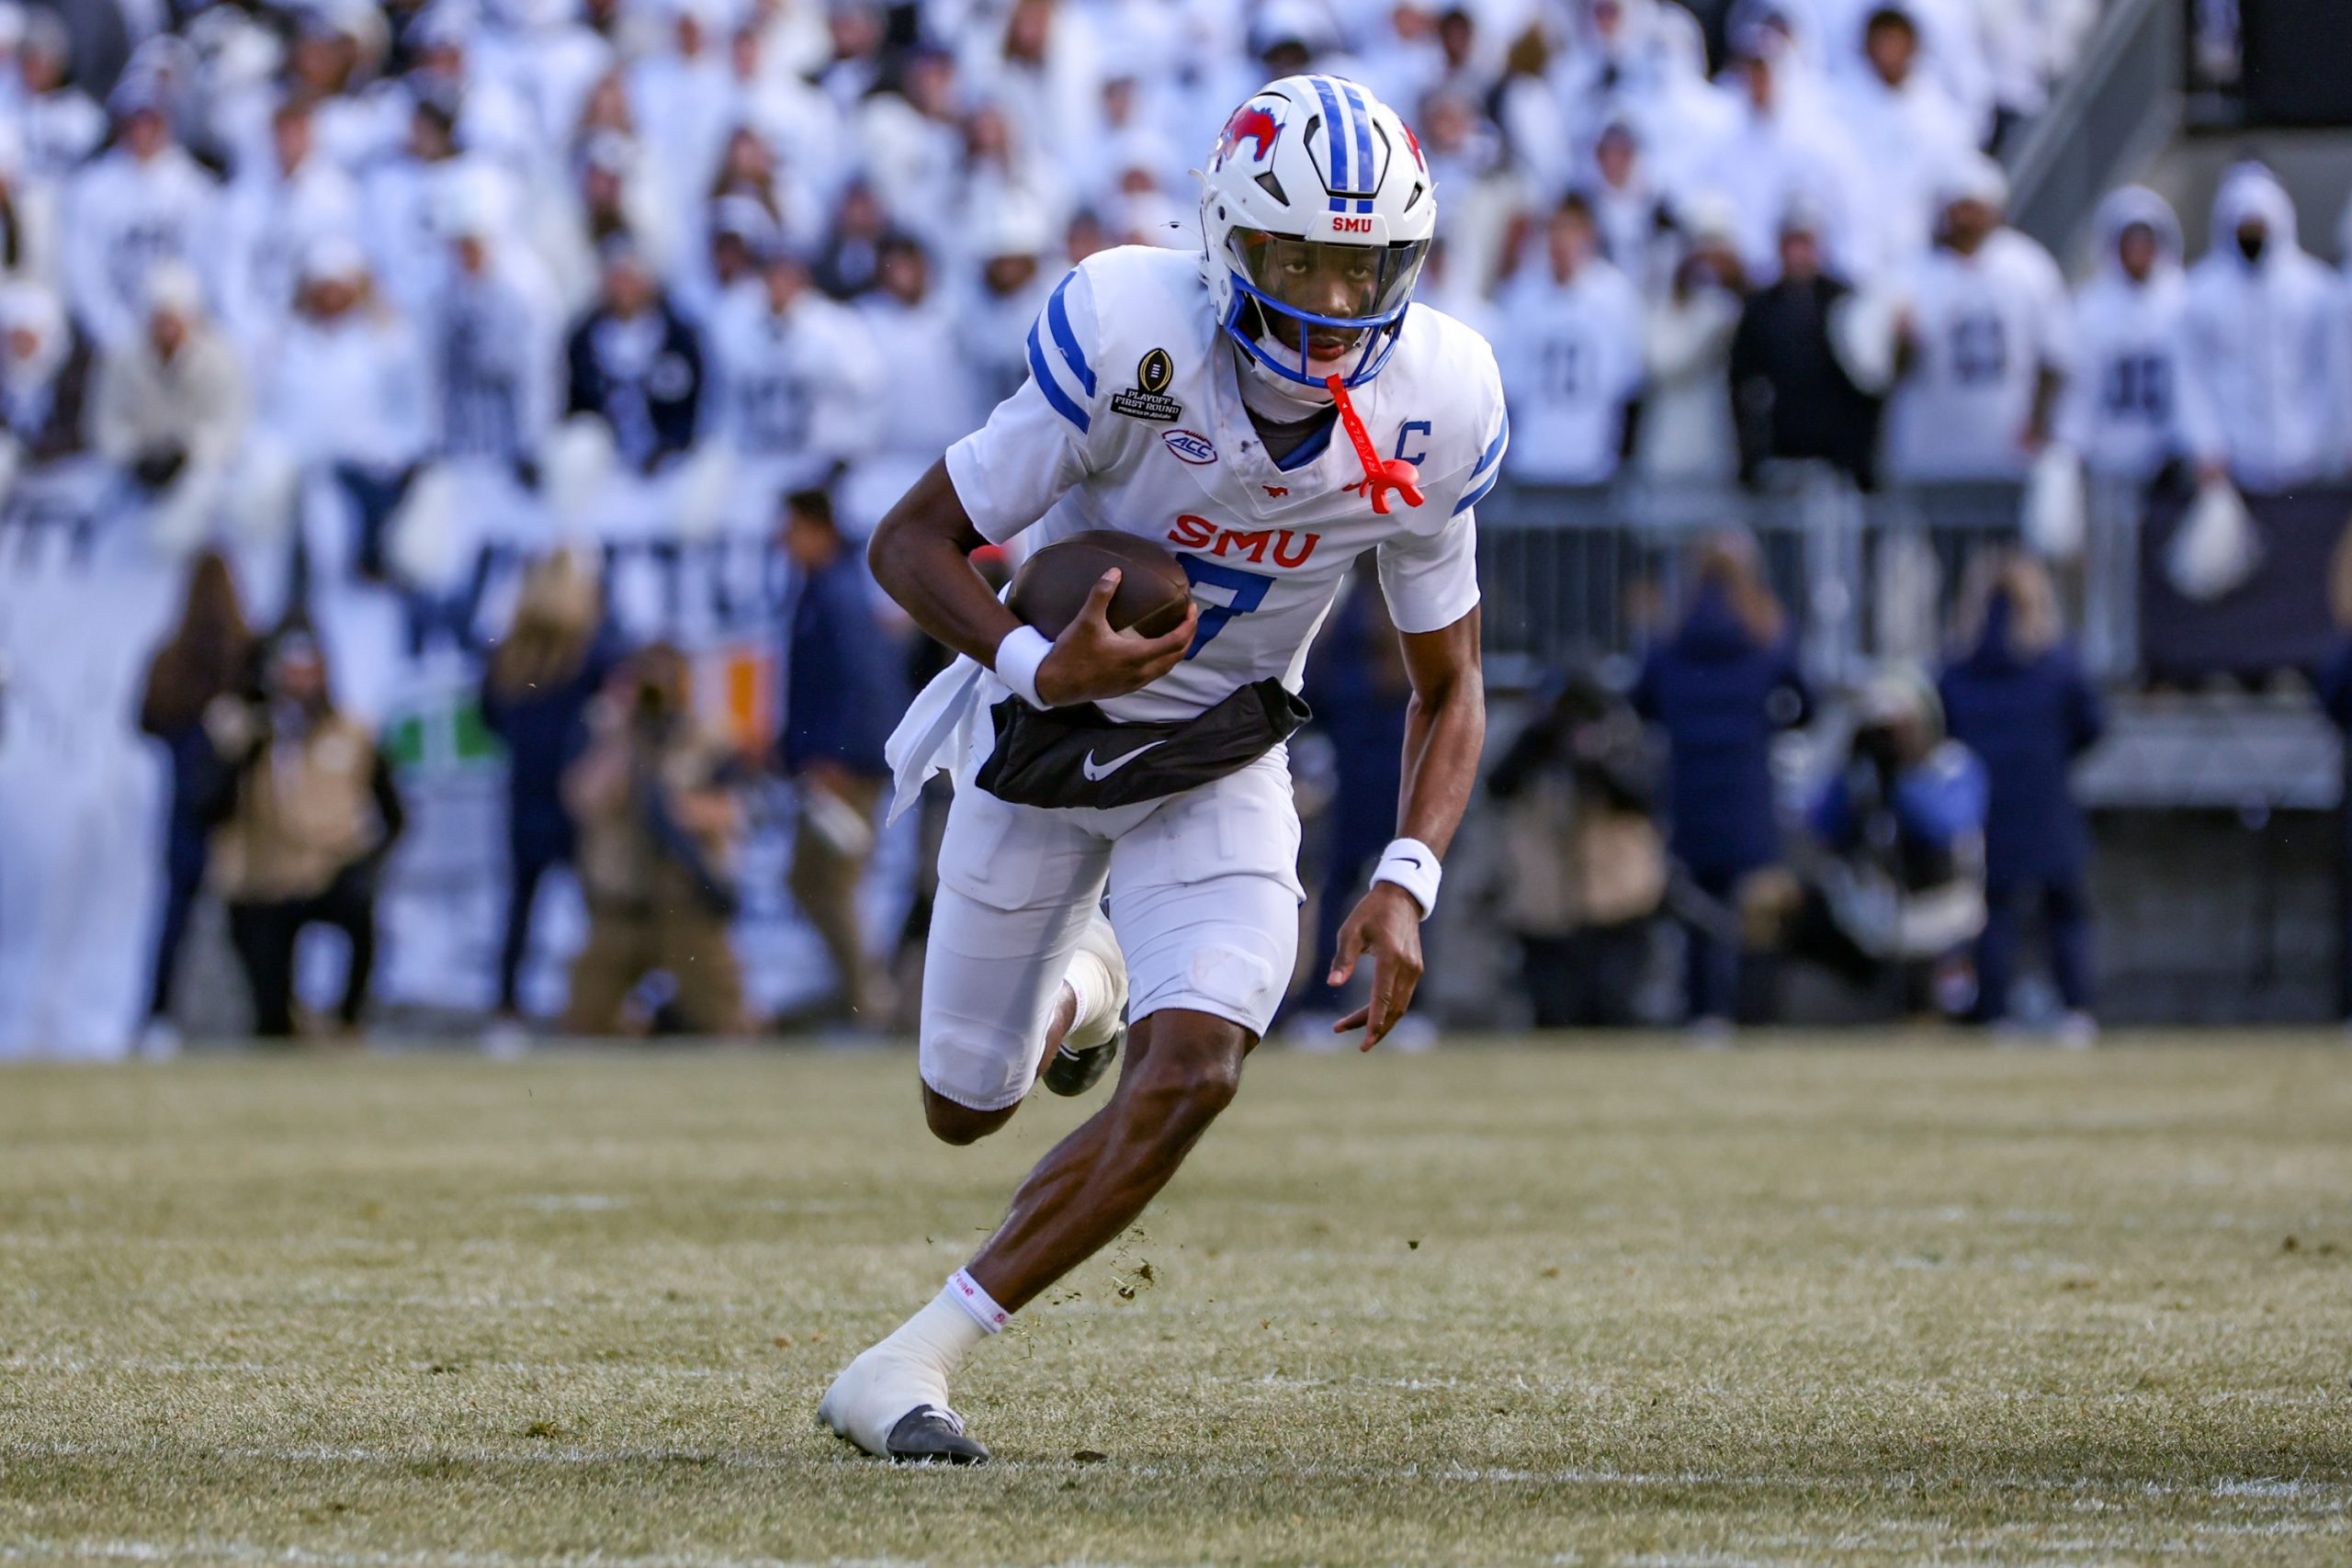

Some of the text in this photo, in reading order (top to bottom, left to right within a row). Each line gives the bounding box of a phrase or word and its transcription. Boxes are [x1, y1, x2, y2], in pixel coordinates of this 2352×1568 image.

[1332, 217, 1373, 233] SMU
[1114, 395, 1180, 414] FIRST ROUND
[1127, 389, 1171, 405] PLAYOFF
[1171, 436, 1215, 457] ACC
[1395, 420, 1431, 467] C
[1167, 513, 1321, 569] SMU
[1175, 551, 1277, 661] 7
